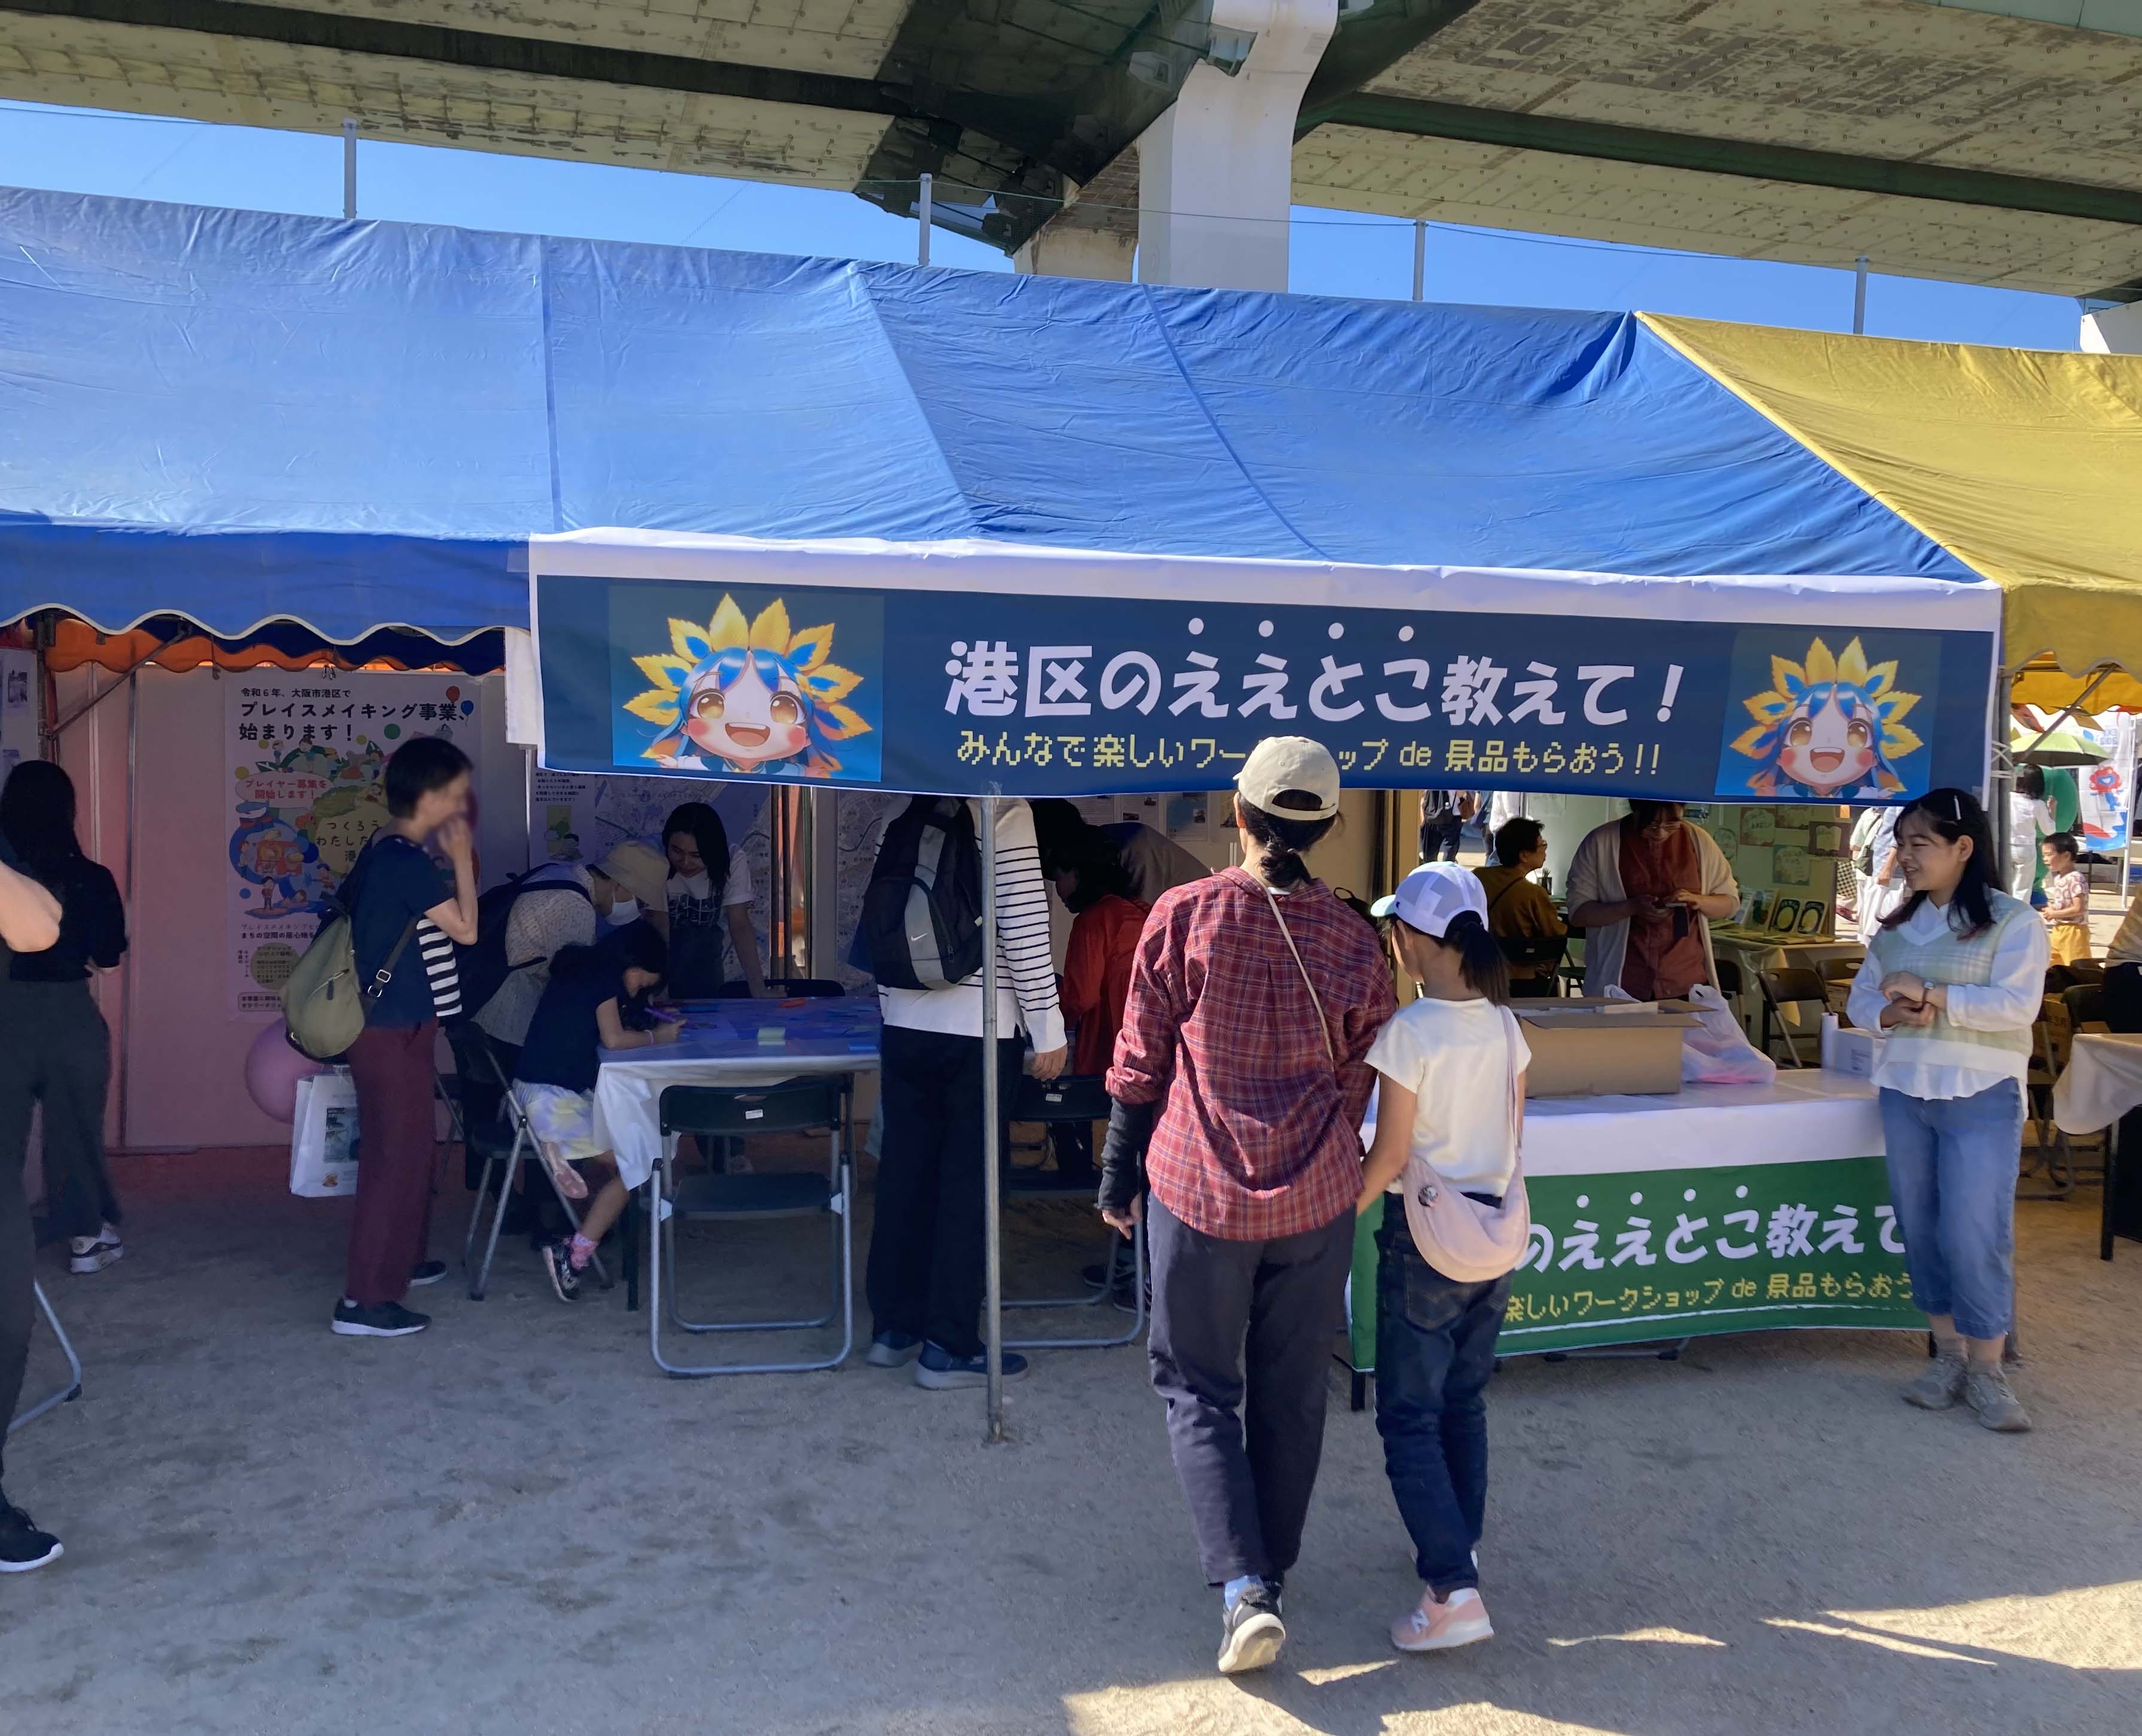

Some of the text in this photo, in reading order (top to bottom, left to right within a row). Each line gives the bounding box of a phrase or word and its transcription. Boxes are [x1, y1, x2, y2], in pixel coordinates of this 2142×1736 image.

[944, 640, 1684, 726] 港区のええとこ教えて！
[241, 703, 465, 720] プレイスメイキング事業、
[239, 723, 352, 741] 始まります！
[958, 730, 1388, 771] みんなで楽しいワーップ
[1399, 740, 1432, 767] de
[245, 779, 327, 789] プレイヤー募集を
[255, 789, 315, 799] 開始します！
[1732, 1278, 1757, 1299] de
